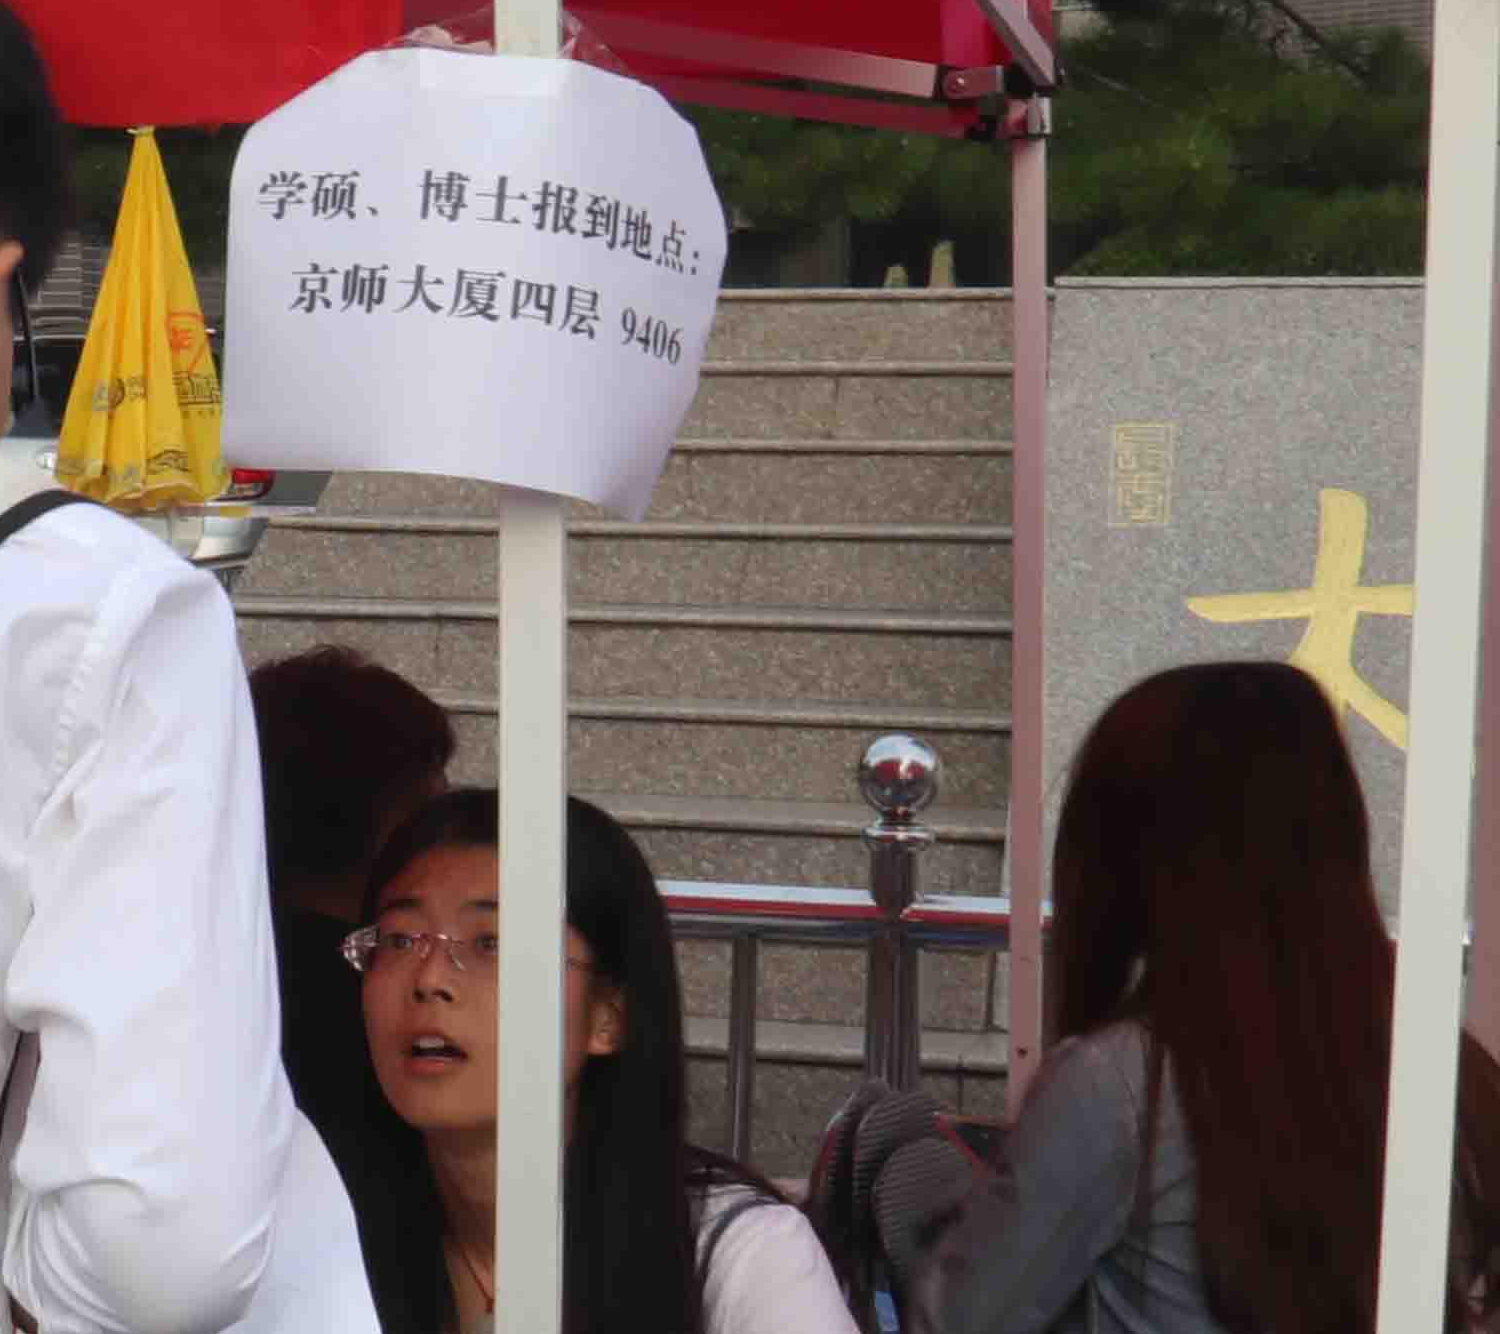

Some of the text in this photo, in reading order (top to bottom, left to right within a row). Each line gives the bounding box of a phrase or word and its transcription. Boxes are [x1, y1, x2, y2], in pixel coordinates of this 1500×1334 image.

[288, 262, 684, 367] 京师大厦四层 9406
